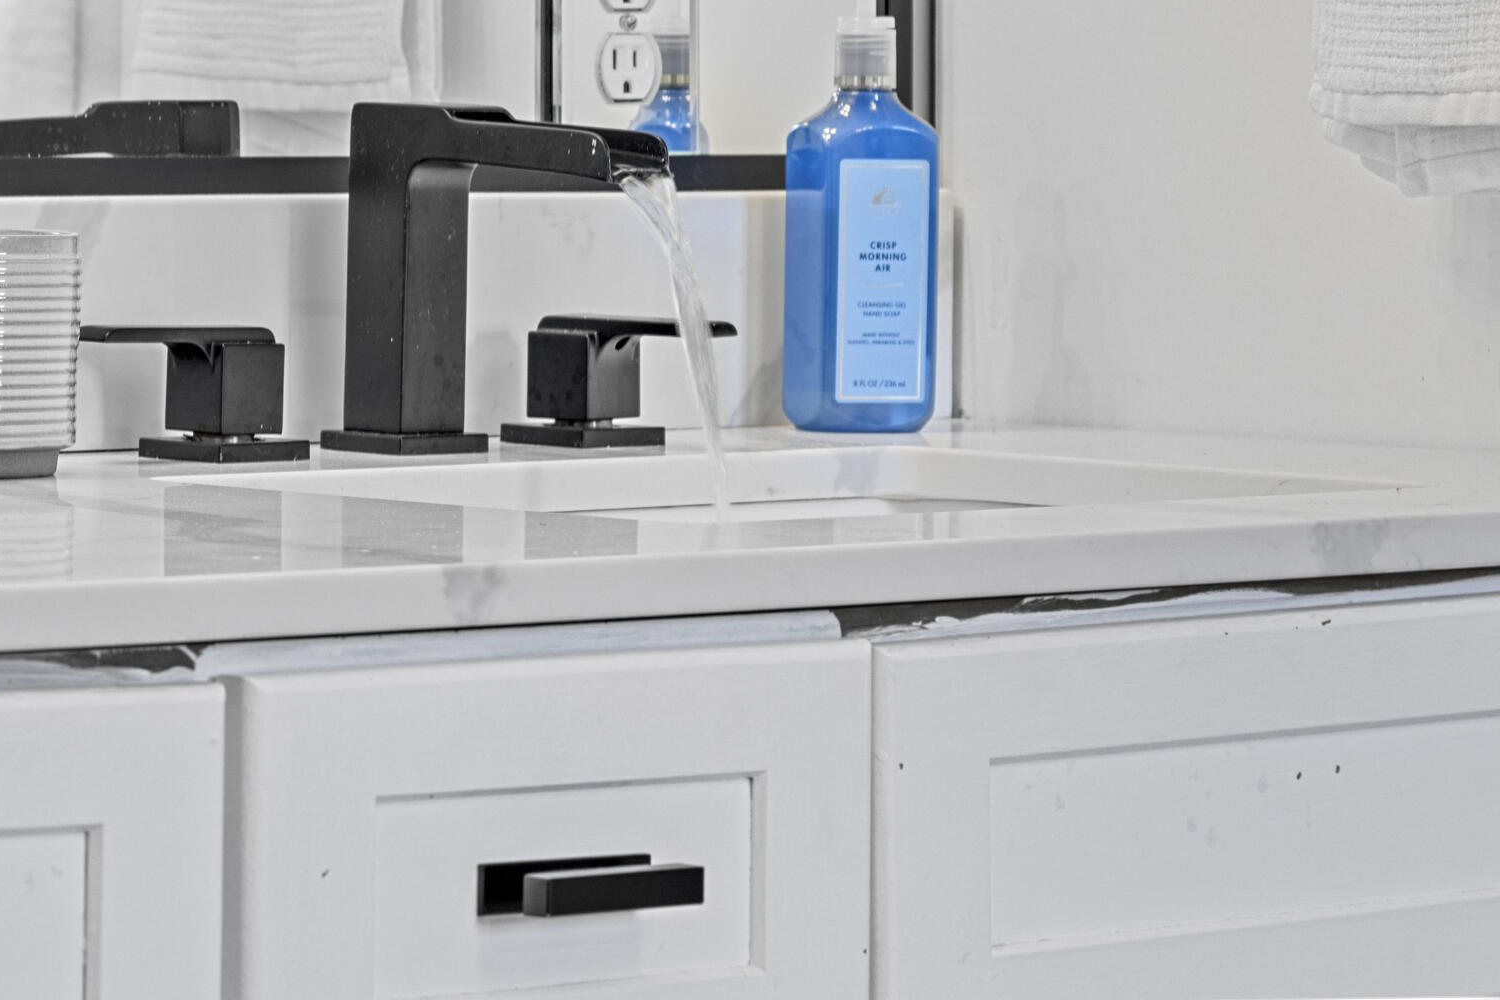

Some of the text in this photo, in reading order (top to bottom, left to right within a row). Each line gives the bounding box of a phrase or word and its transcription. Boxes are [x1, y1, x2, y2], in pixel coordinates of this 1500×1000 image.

[870, 240, 897, 250] CRISP
[859, 252, 908, 262] MORNING
[874, 263, 891, 273] AIR
[857, 301, 907, 309] CLEANSING GEL
[859, 380, 866, 388] FL
[867, 380, 878, 388] OZ
